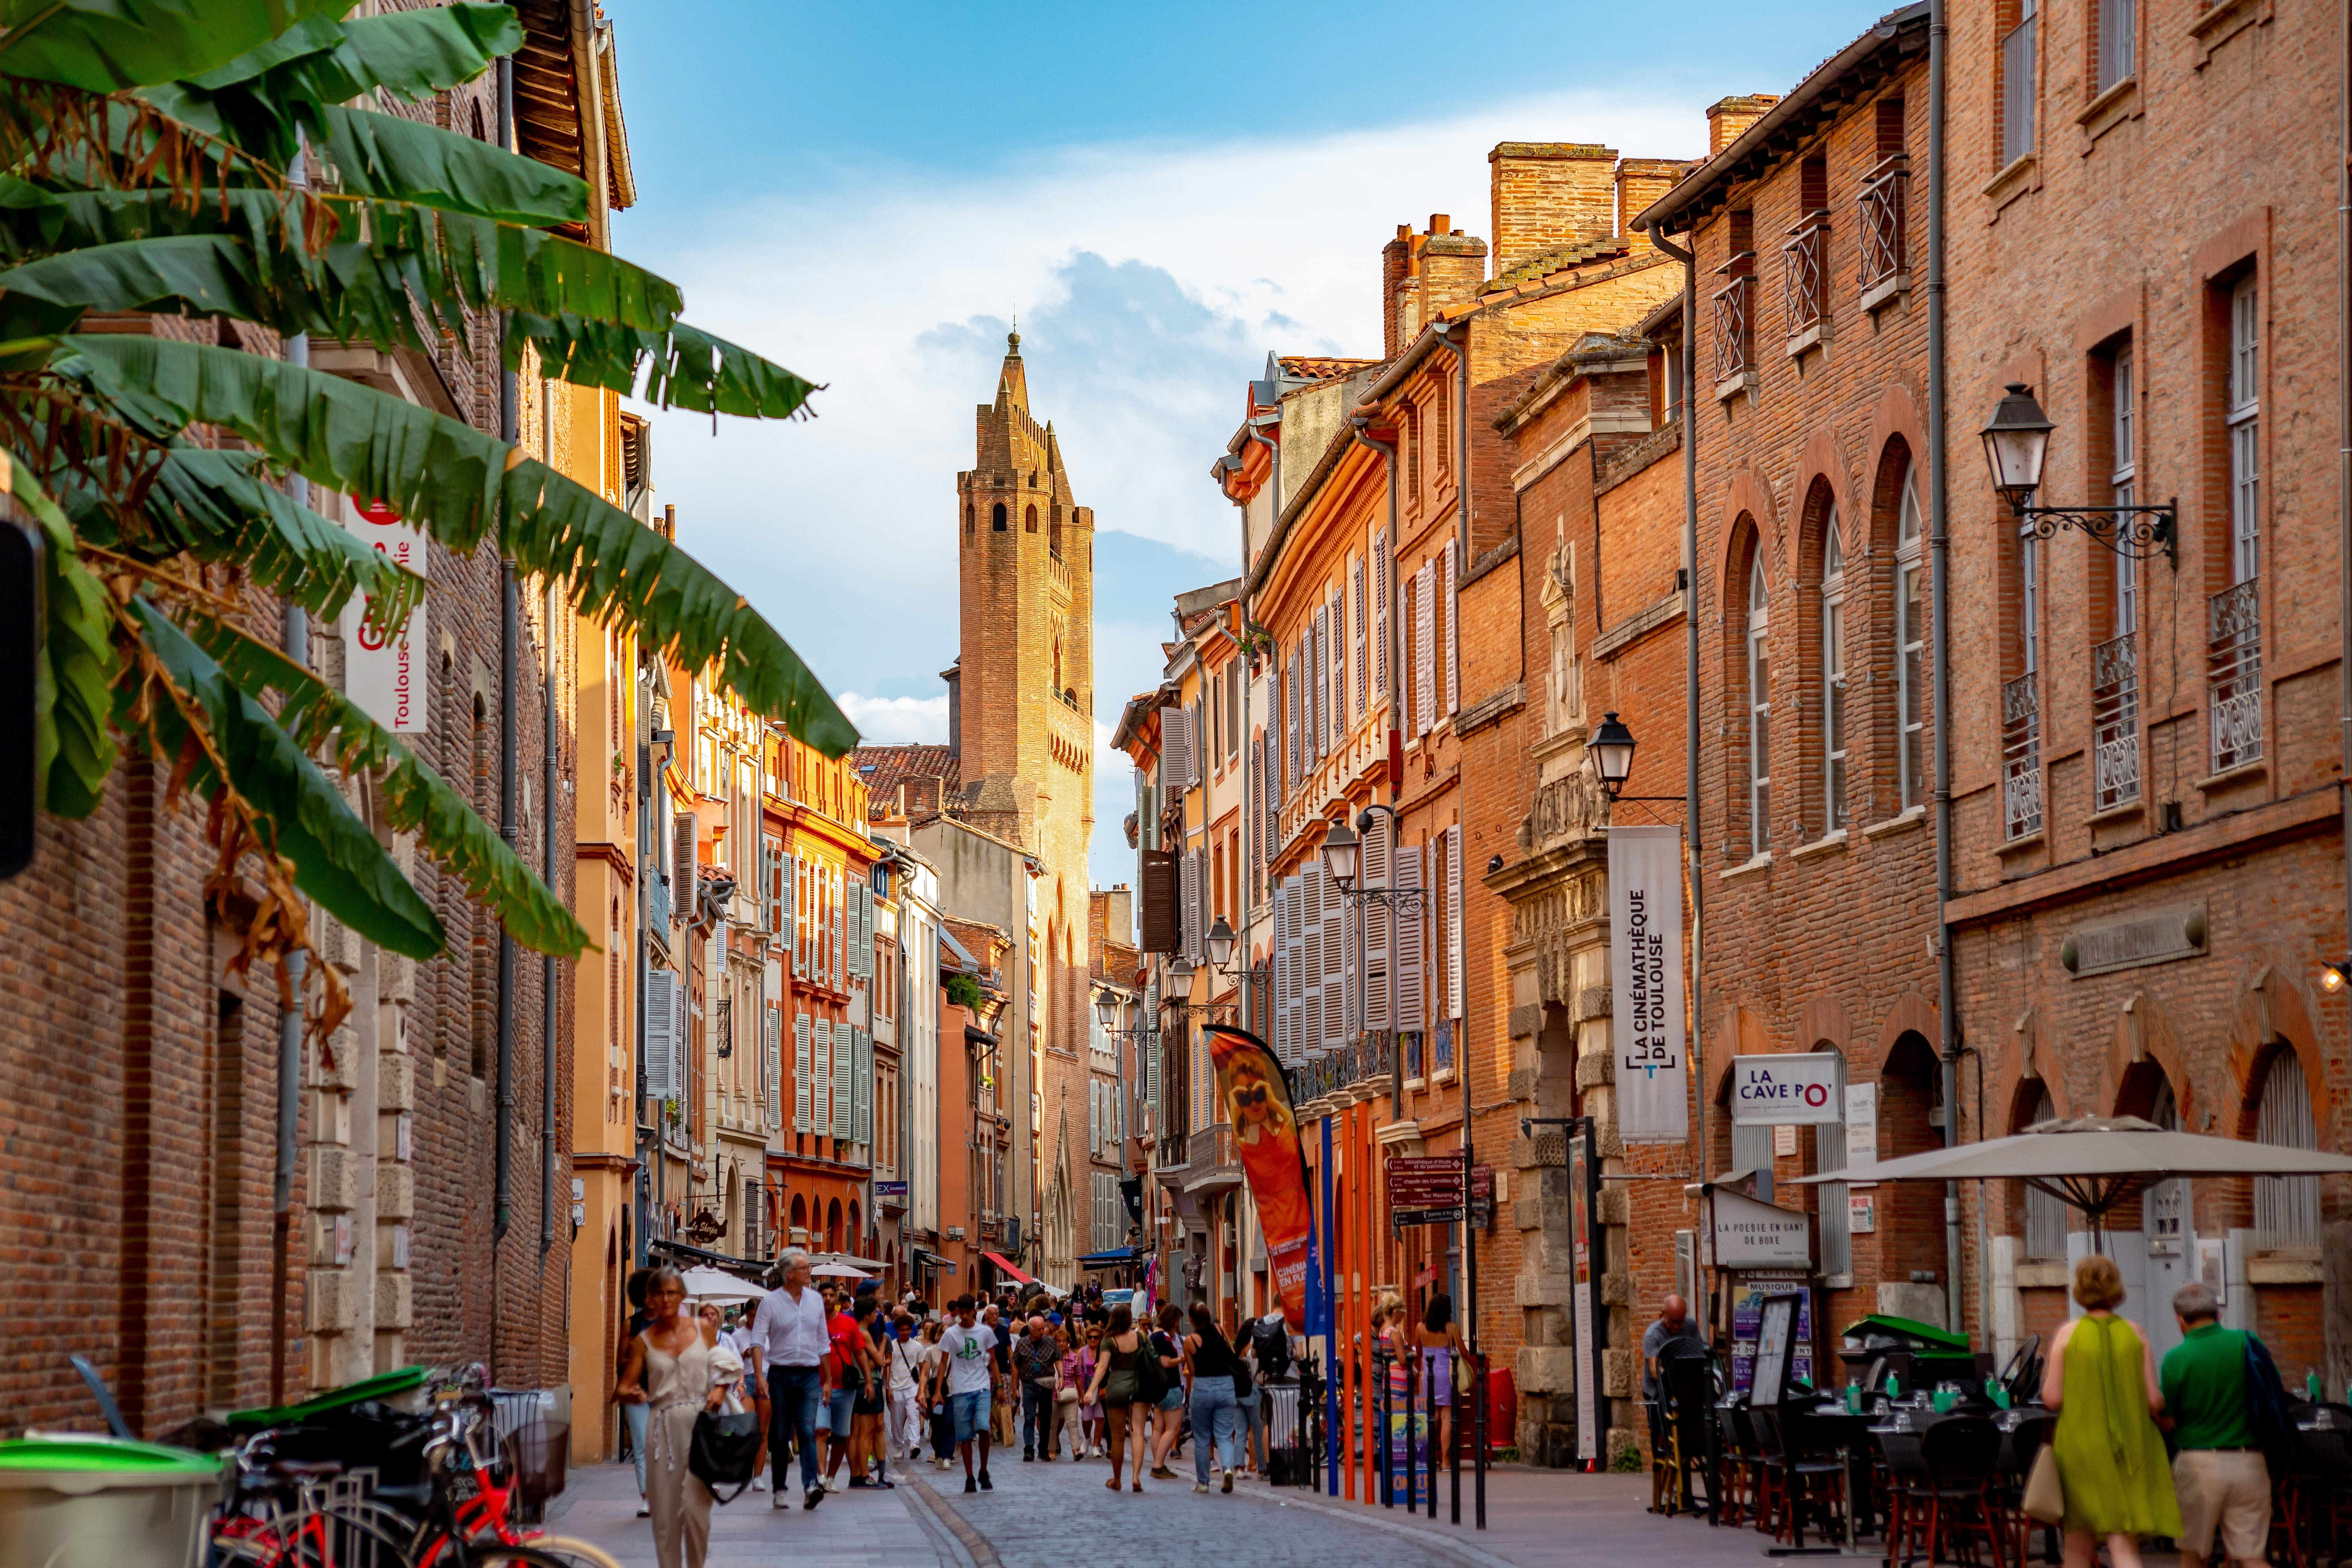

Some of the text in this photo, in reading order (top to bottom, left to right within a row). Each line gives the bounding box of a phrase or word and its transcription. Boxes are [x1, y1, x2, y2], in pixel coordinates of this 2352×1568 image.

[394, 641, 409, 728] Toulouse
[1628, 889, 1648, 1060] LA CINÉMATHÈQUE
[1649, 933, 1666, 1059] DE TOULOUSE
[1751, 1070, 1773, 1083] LA
[1741, 1085, 1788, 1099] CAVE
[699, 1222, 718, 1236] Sherpa
[1770, 1224, 1780, 1232] EN
[1784, 1224, 1804, 1232] GANT
[1745, 1236, 1780, 1245] DE BOXE
[1277, 1261, 1307, 1278] CINÉMA
[1279, 1276, 1292, 1287] EN
